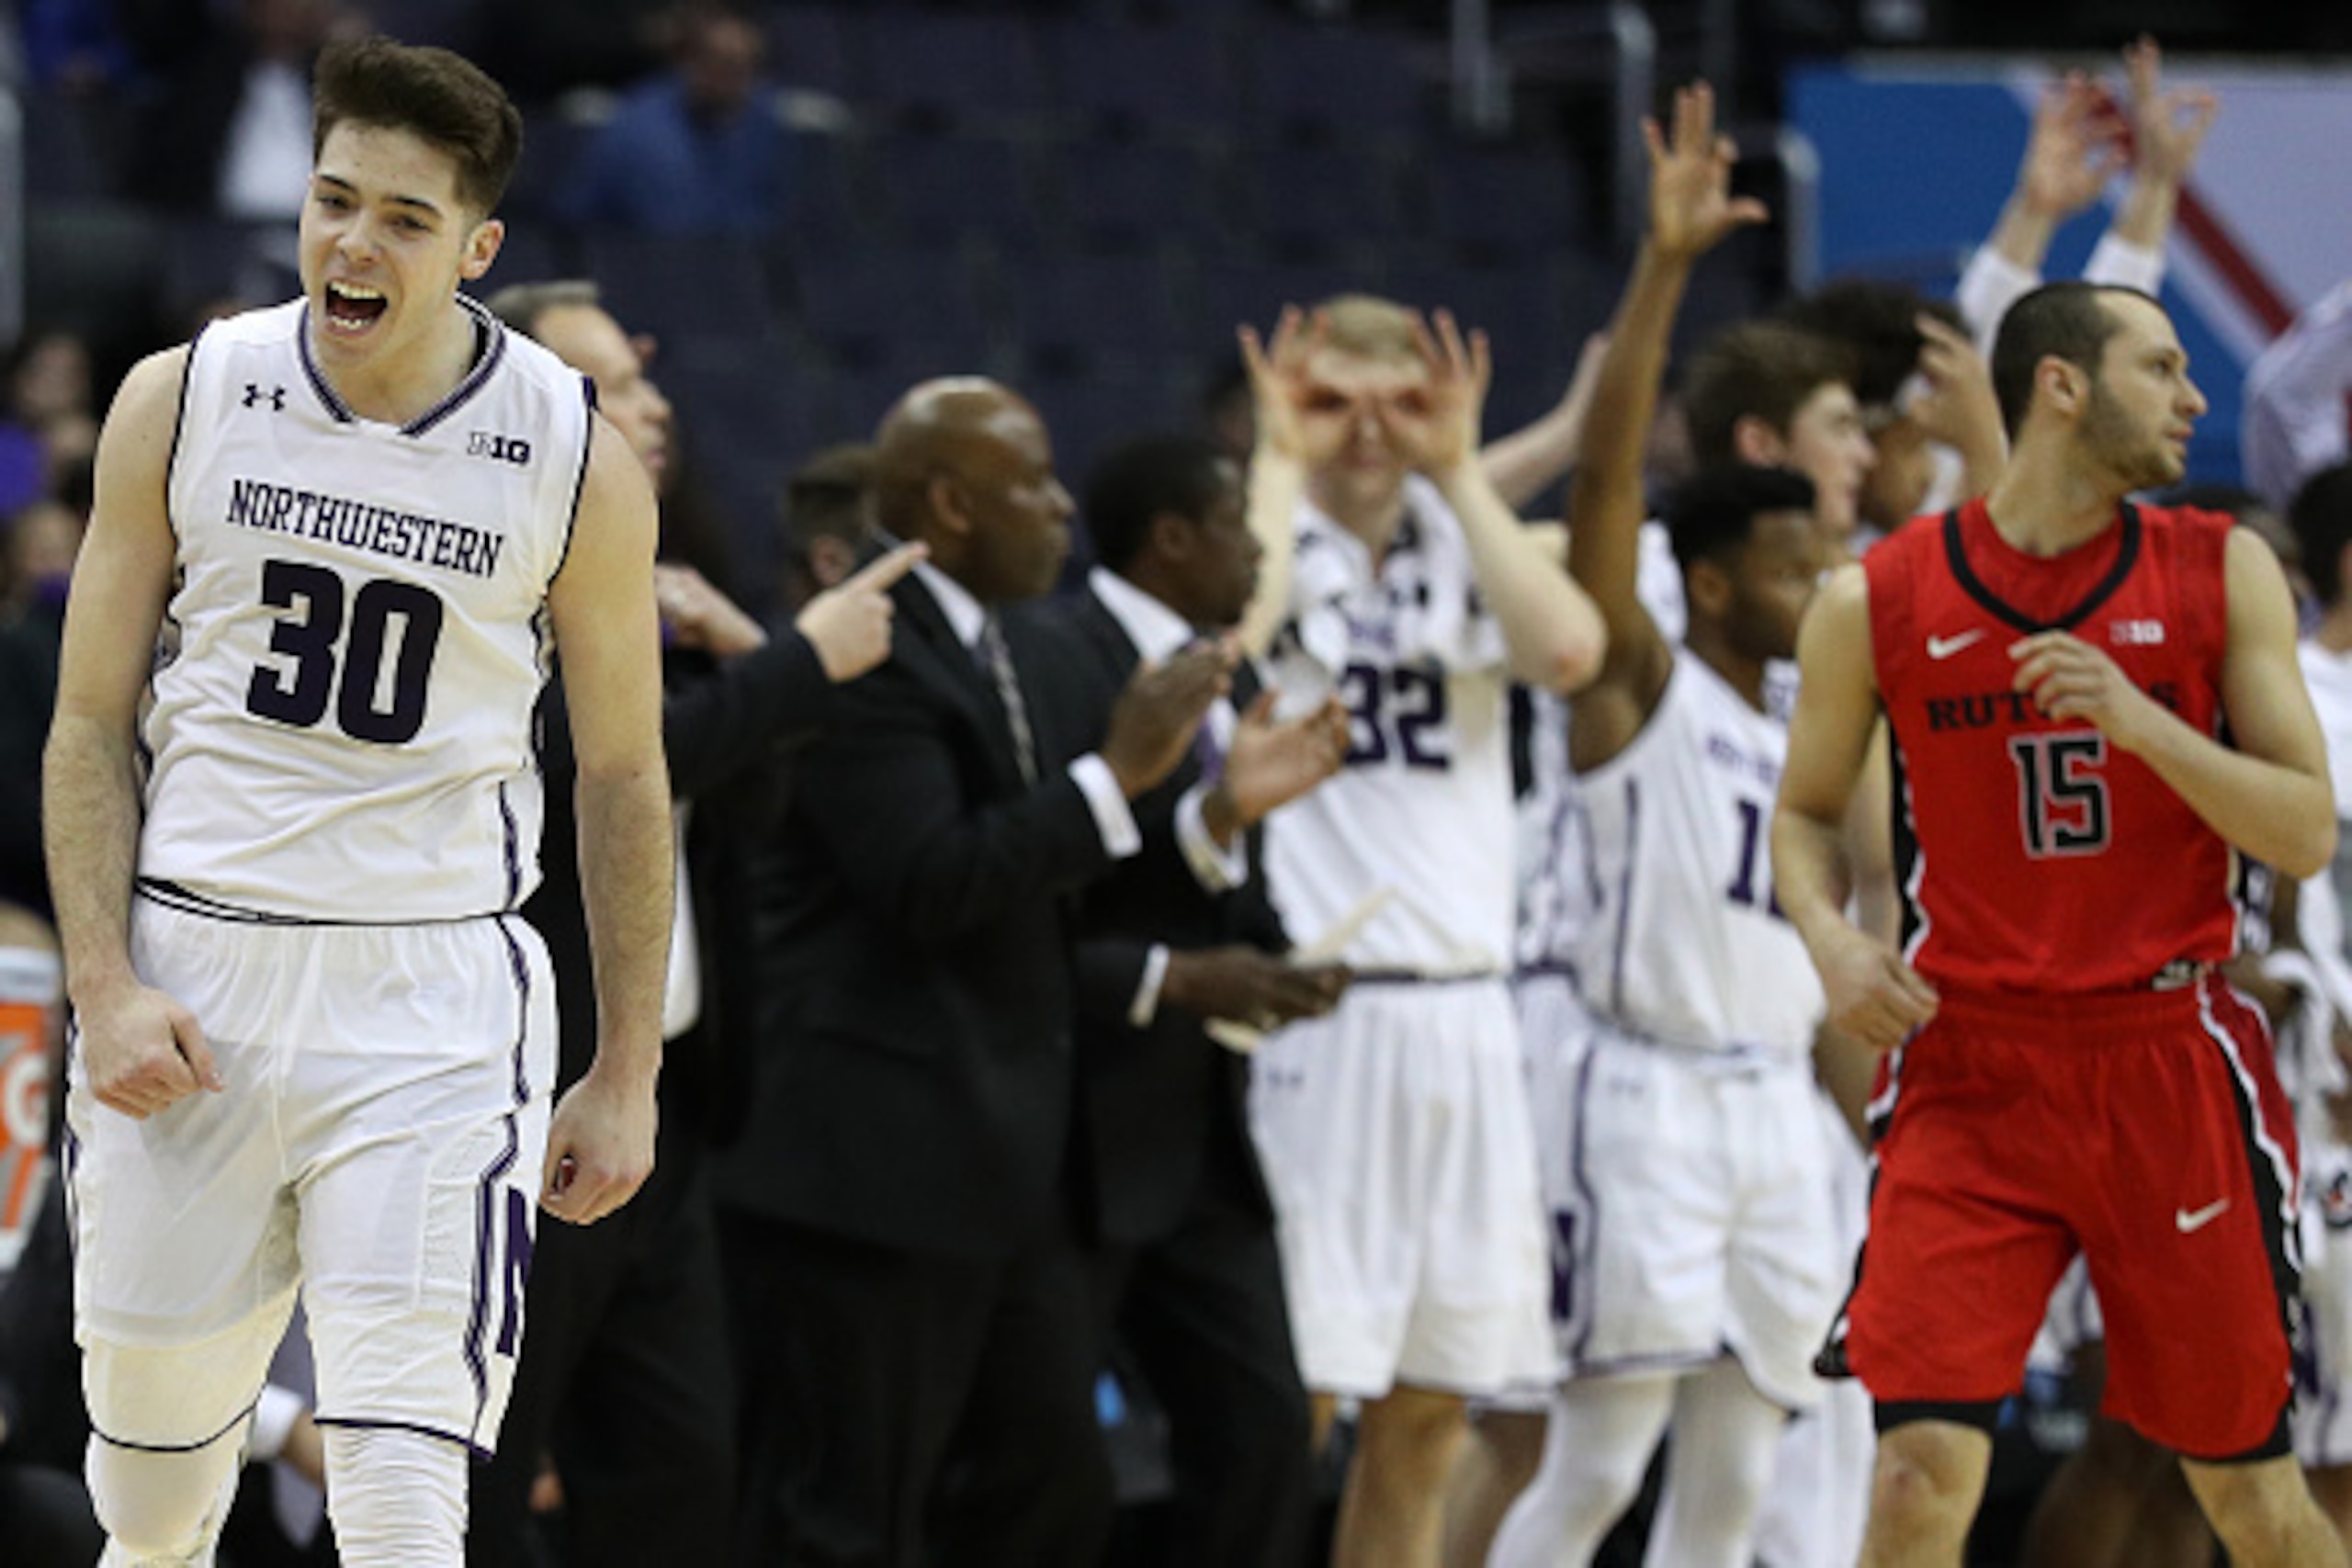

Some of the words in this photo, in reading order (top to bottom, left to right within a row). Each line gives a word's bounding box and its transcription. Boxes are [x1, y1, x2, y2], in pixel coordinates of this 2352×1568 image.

[226, 479, 503, 578] NORTHWESTERN
[245, 558, 443, 745] 30
[1926, 682, 2180, 730] RUTS
[1340, 656, 1453, 768] 32
[2007, 729, 2110, 858] 15
